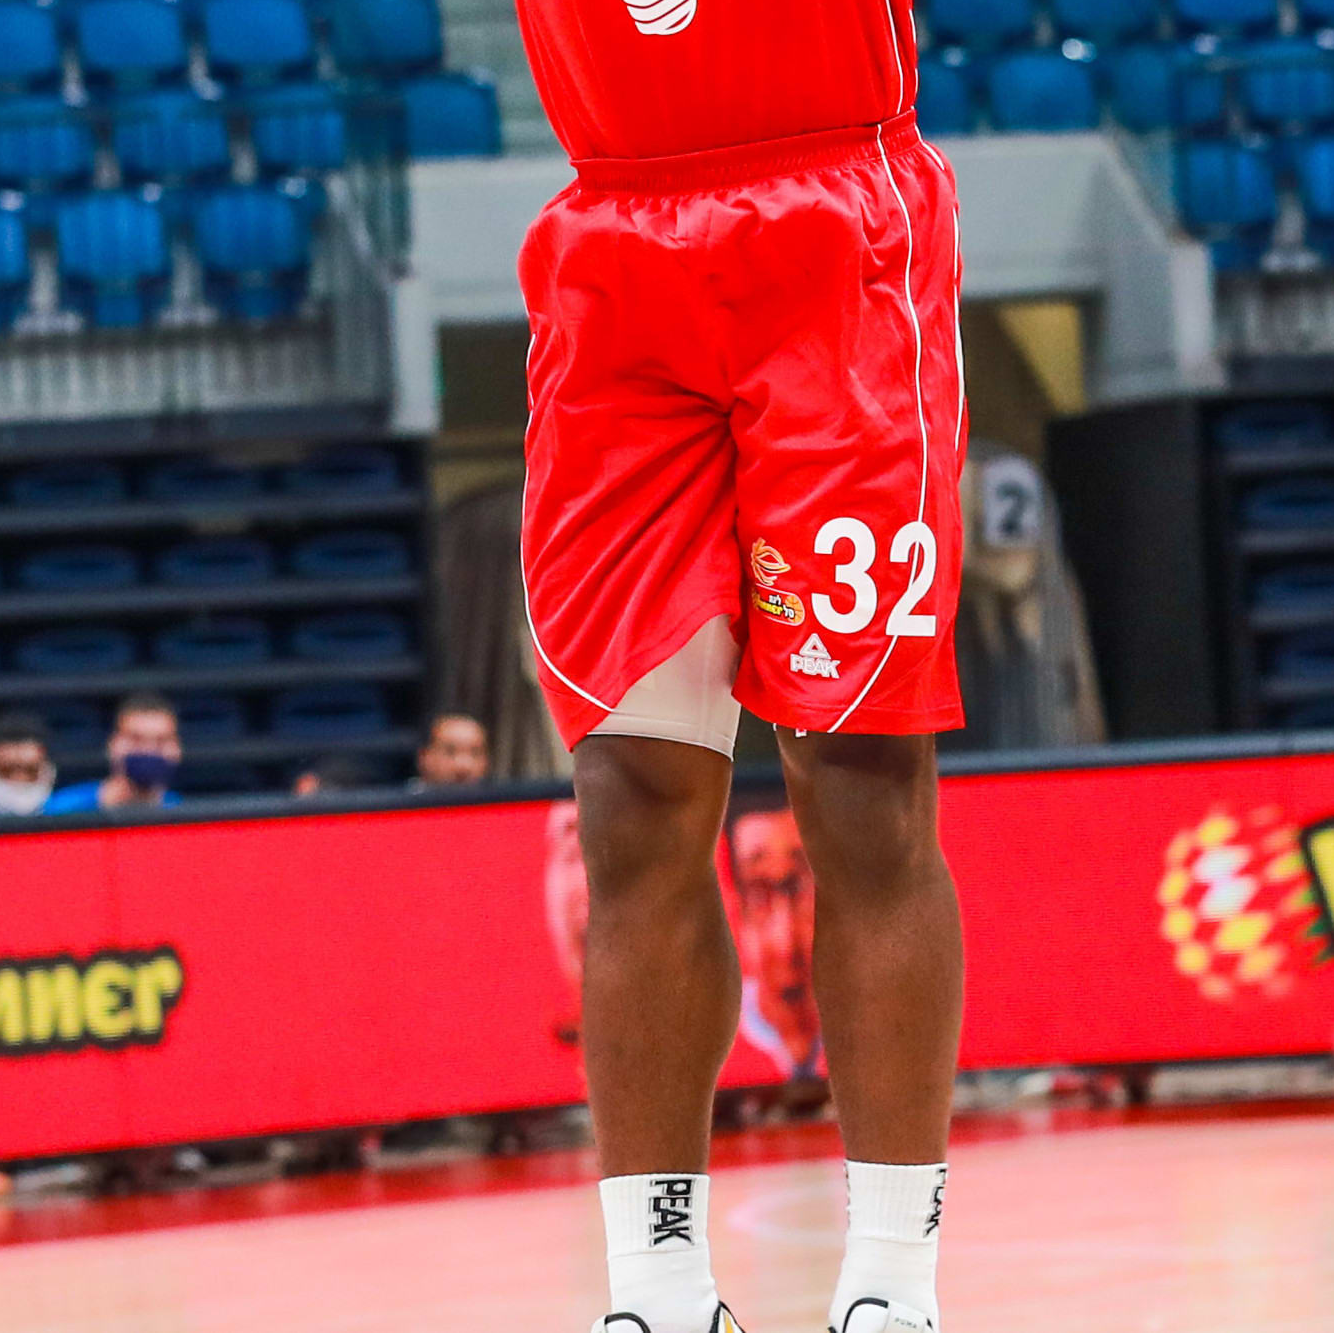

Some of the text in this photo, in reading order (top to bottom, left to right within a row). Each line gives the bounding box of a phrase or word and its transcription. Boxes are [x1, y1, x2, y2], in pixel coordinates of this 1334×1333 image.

[811, 517, 937, 637] 32
[790, 653, 841, 679] PEAK
[650, 1178, 694, 1246] PEAK
